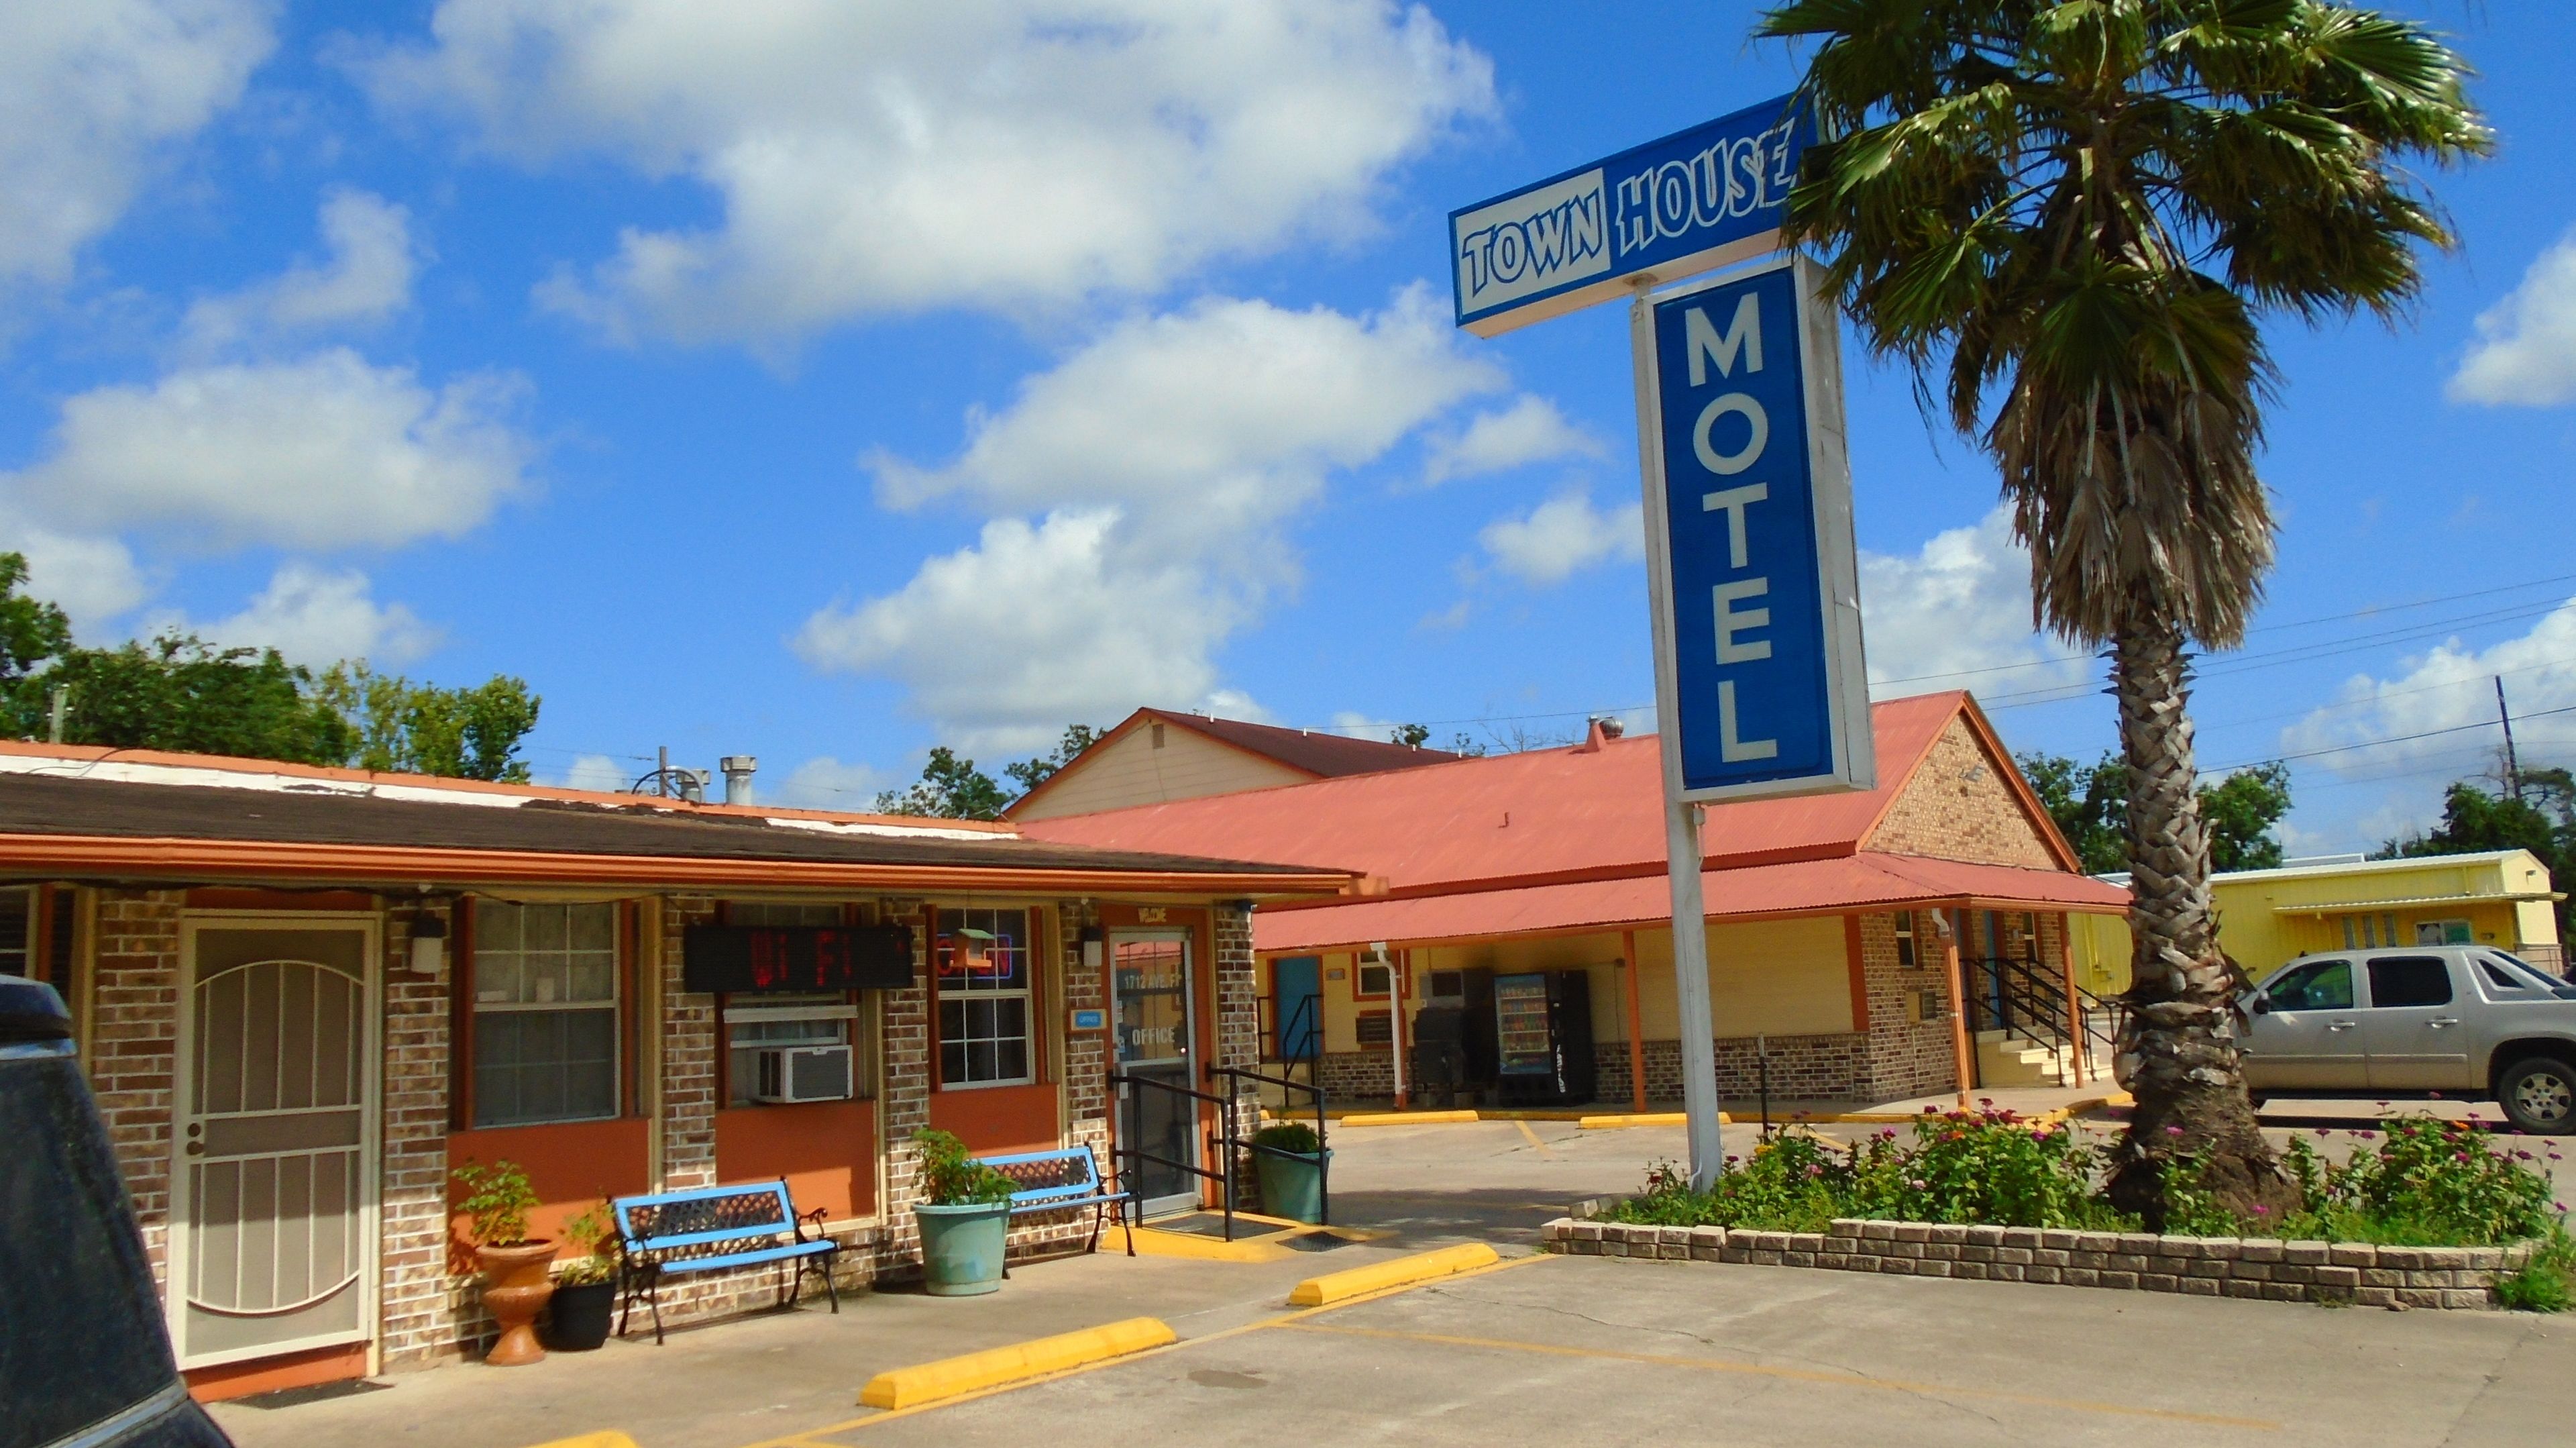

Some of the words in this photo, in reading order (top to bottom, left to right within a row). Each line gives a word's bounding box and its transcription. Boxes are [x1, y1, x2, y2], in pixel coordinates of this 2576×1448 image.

[1461, 186, 1604, 298] TOWN
[1615, 116, 1799, 258] HOUSE
[1684, 291, 1778, 764] MOTEL
[1124, 974, 1146, 989] 1712
[1132, 1026, 1175, 1046] OFFICE
